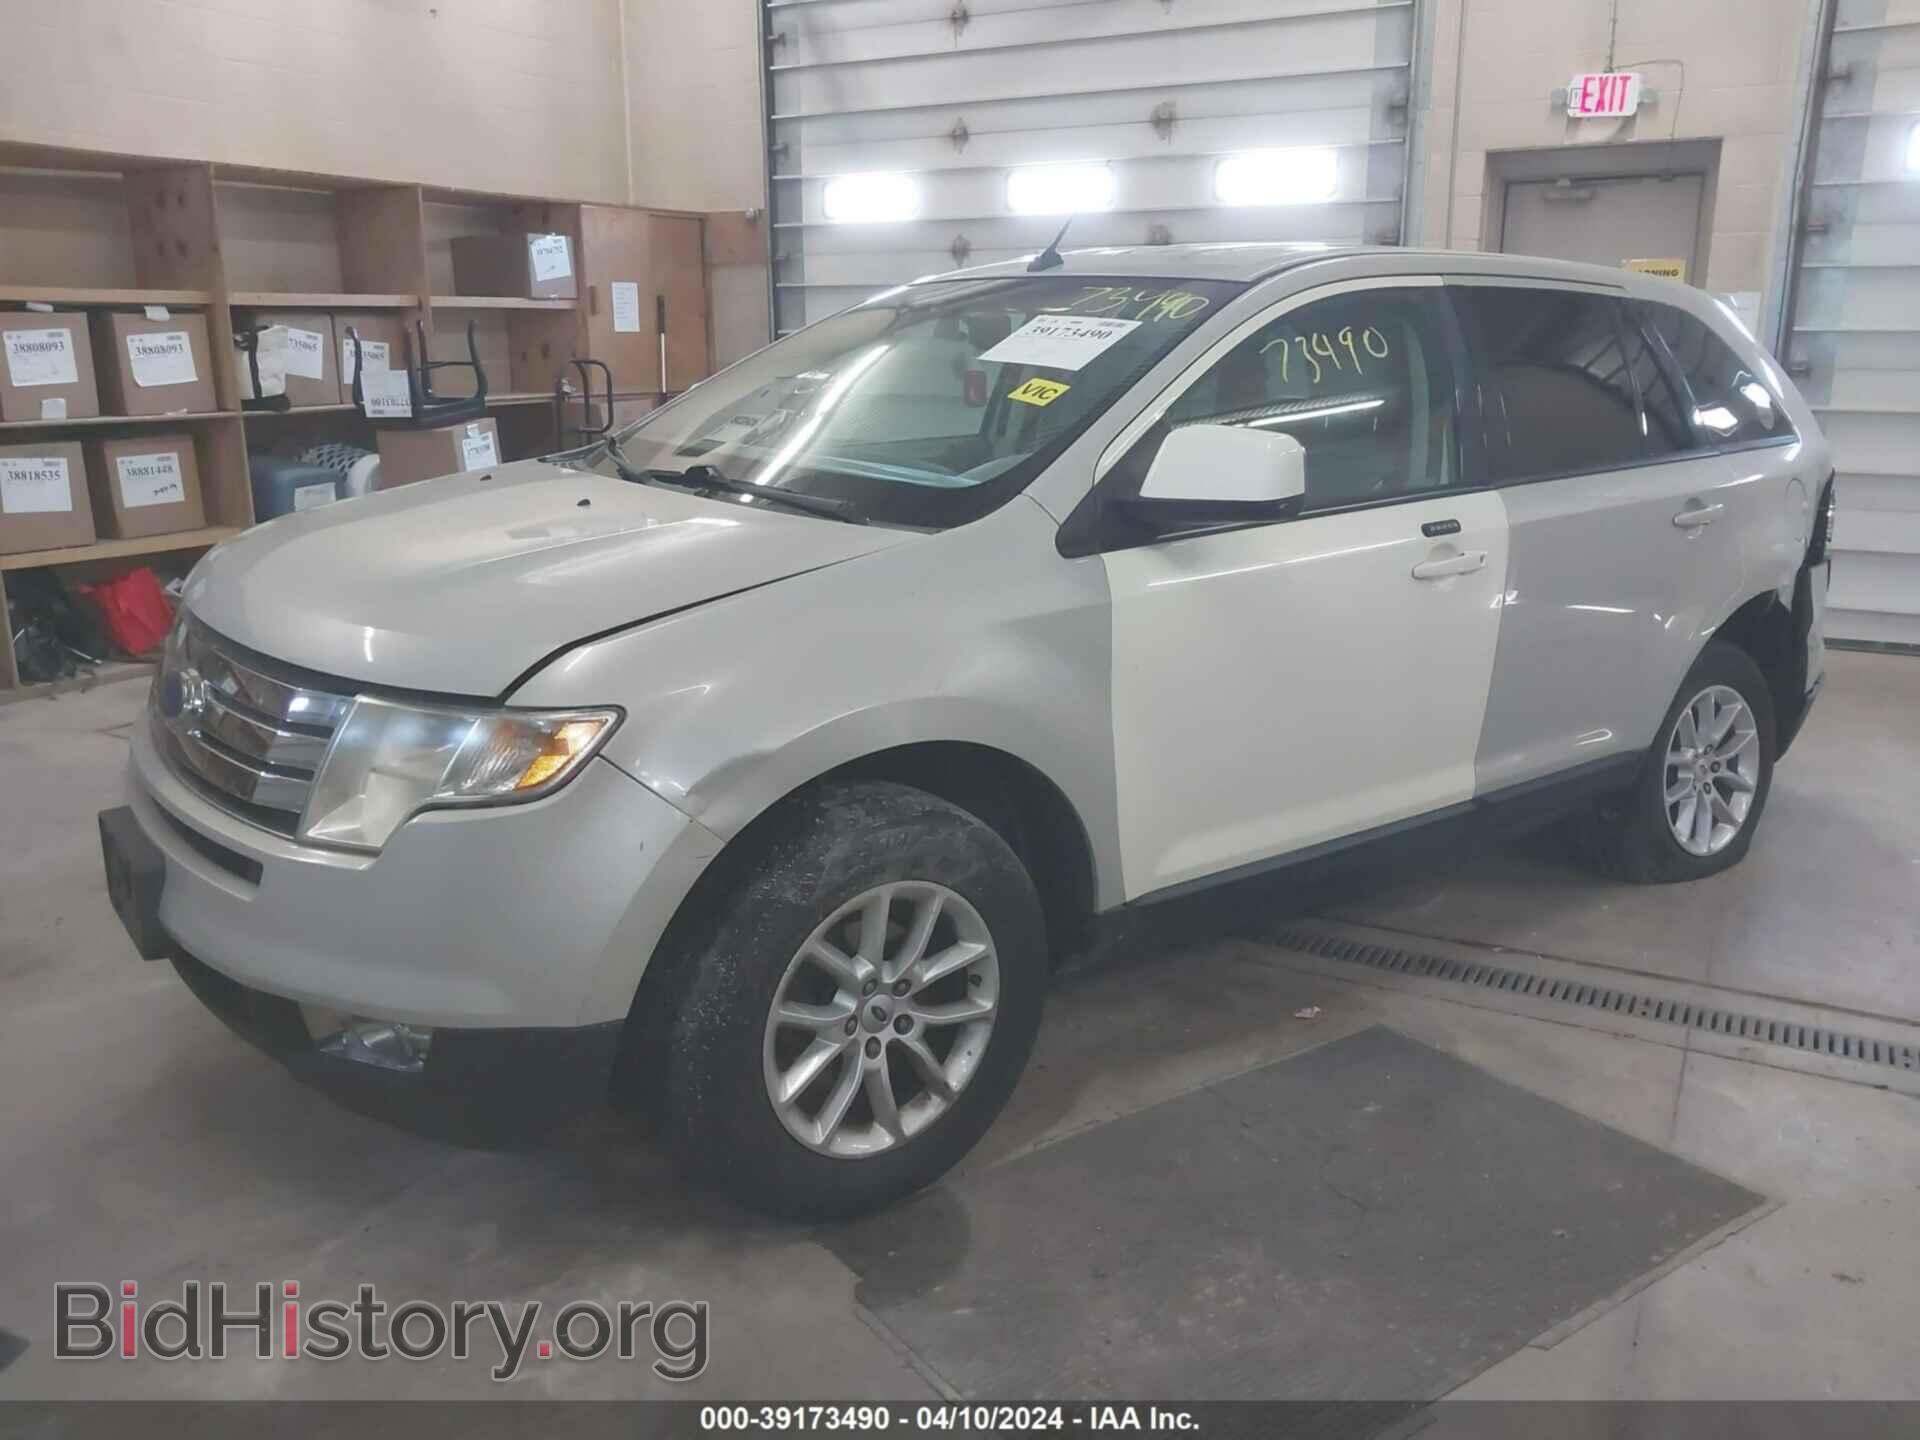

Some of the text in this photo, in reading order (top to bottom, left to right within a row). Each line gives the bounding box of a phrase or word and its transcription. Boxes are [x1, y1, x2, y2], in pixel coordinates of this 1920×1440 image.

[1580, 76, 1632, 112] EXIT
[1069, 286, 1210, 323] 73490
[1025, 326, 1113, 340] 39173490
[13, 341, 65, 354] 38808093
[135, 343, 184, 357] 38808093
[1259, 326, 1389, 384] 73490
[1019, 383, 1059, 400] VIC
[7, 470, 62, 481] 38818535
